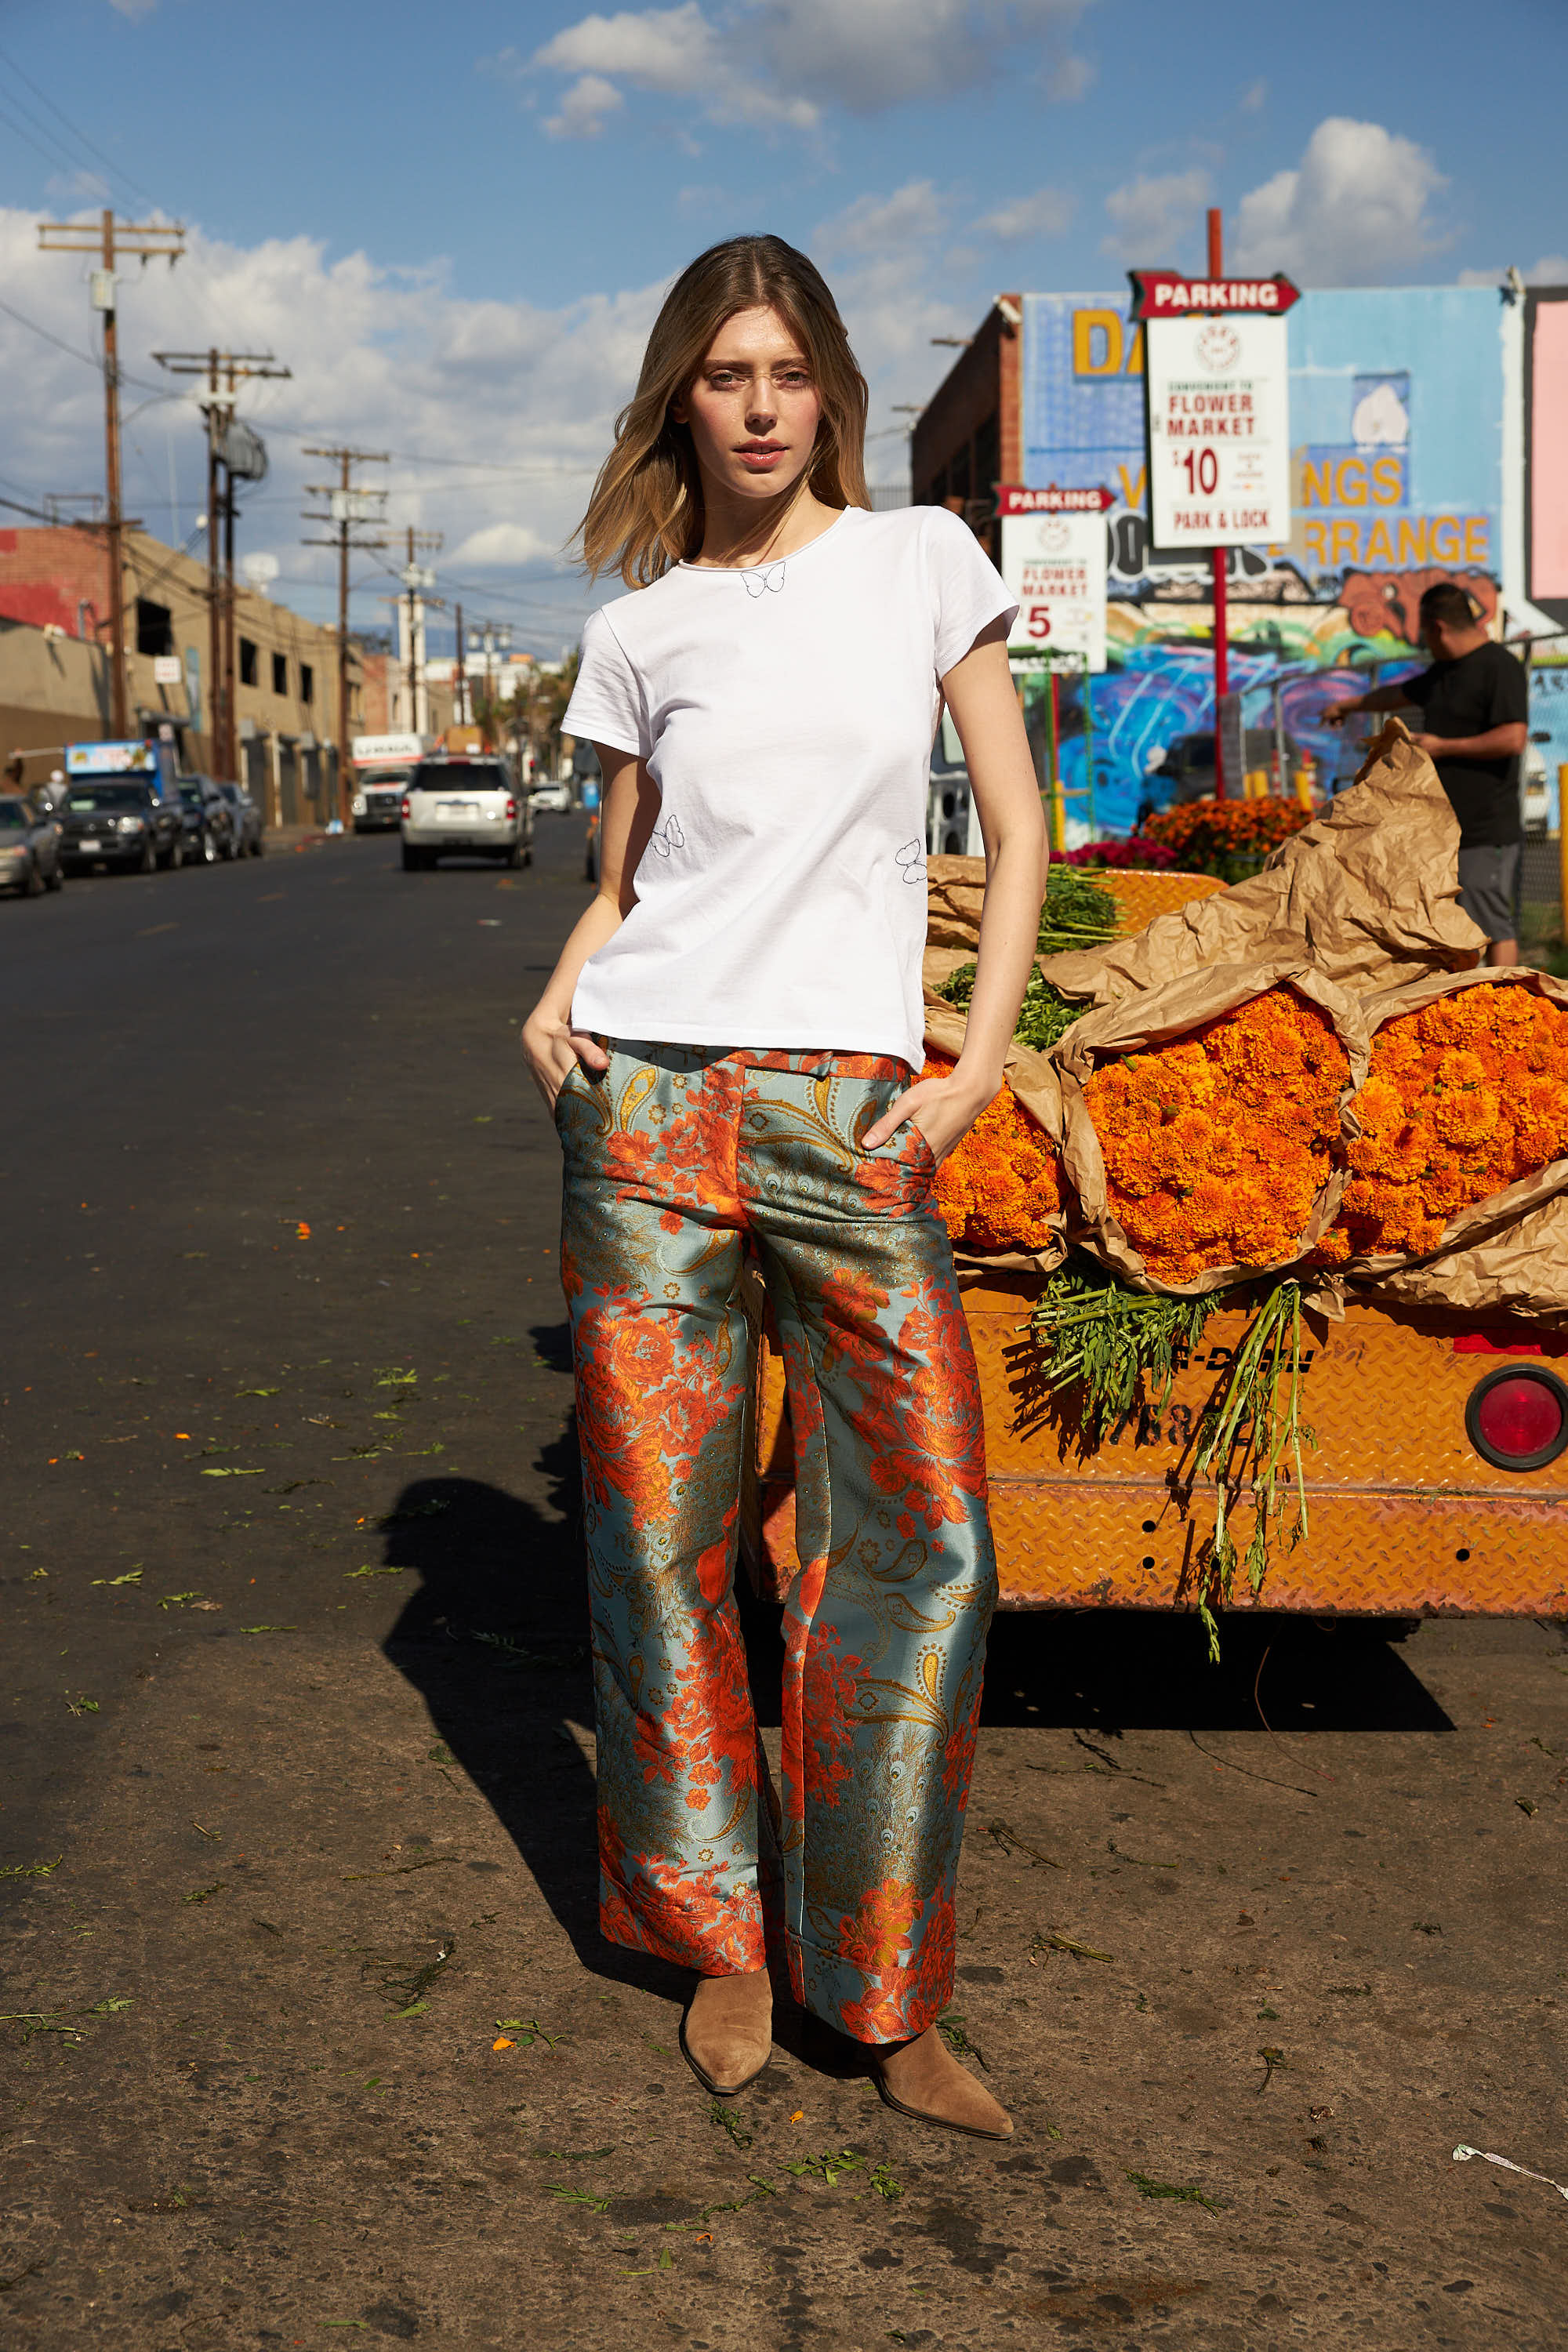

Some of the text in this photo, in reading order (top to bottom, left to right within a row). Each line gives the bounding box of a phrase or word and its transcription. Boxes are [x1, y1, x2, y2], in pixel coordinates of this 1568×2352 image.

[1155, 283, 1279, 307] PARKING
[1167, 394, 1252, 413] FLOWER
[1167, 417, 1254, 437] MARKET
[1008, 491, 1102, 510] PARKING
[1174, 510, 1269, 530] PARK & LOCK
[1022, 566, 1087, 580] FLOWER
[1022, 583, 1087, 596] MARKET
